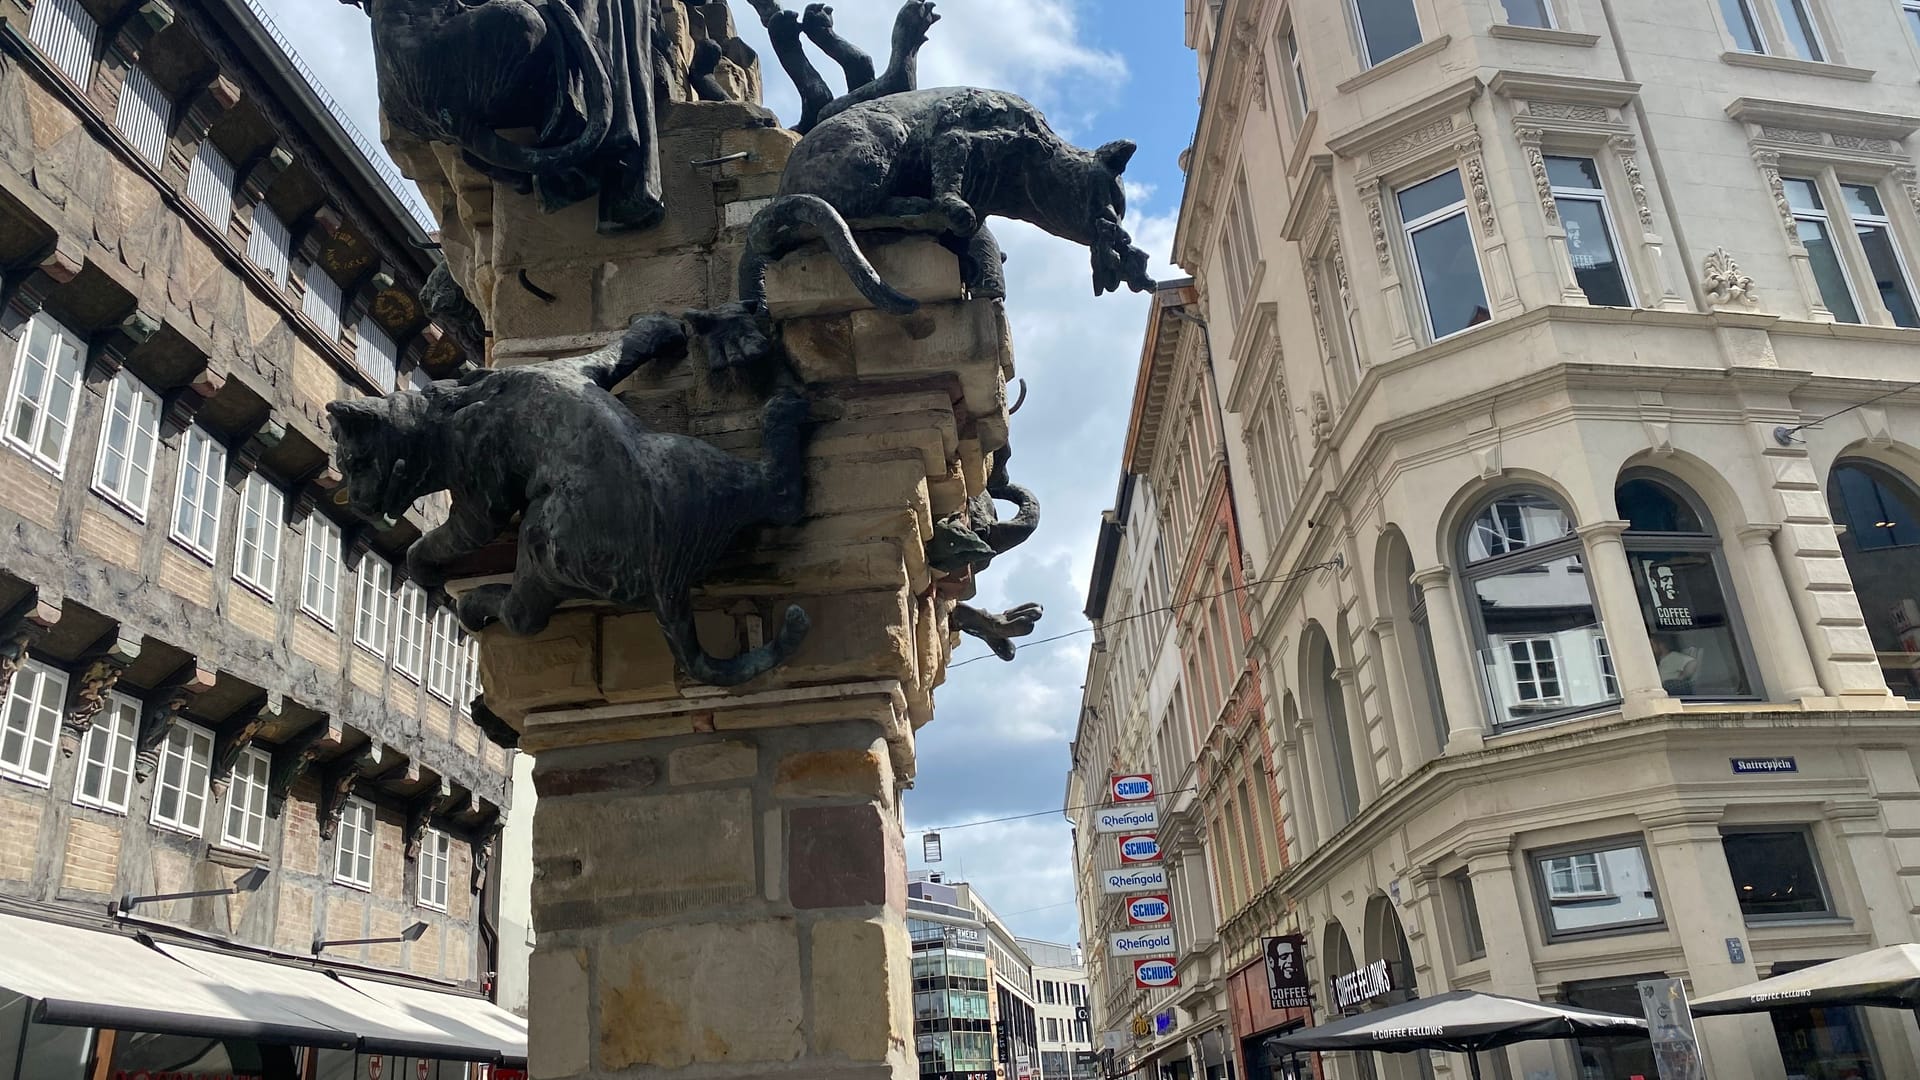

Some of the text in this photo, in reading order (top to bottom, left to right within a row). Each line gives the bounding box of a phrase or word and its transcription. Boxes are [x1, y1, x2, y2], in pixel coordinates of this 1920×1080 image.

[1657, 608, 1690, 617] COFFEE
[1737, 759, 1792, 771] Kattreppeln
[1117, 781, 1150, 795] SCHUHE
[1101, 811, 1154, 827] Rheingold
[1124, 841, 1157, 856] SCHUHE
[1109, 872, 1163, 887] Rheingold
[1132, 902, 1166, 917] SCHUHE
[1116, 934, 1171, 951] Rheingold
[1140, 965, 1174, 981] SCHUHE
[1336, 959, 1390, 1007] COFFEE FELLOWS
[1271, 987, 1306, 999] COFFEE
[1272, 998, 1308, 1008] FELLOWS
[1378, 1025, 1443, 1039] COFFEE FELLOWS
